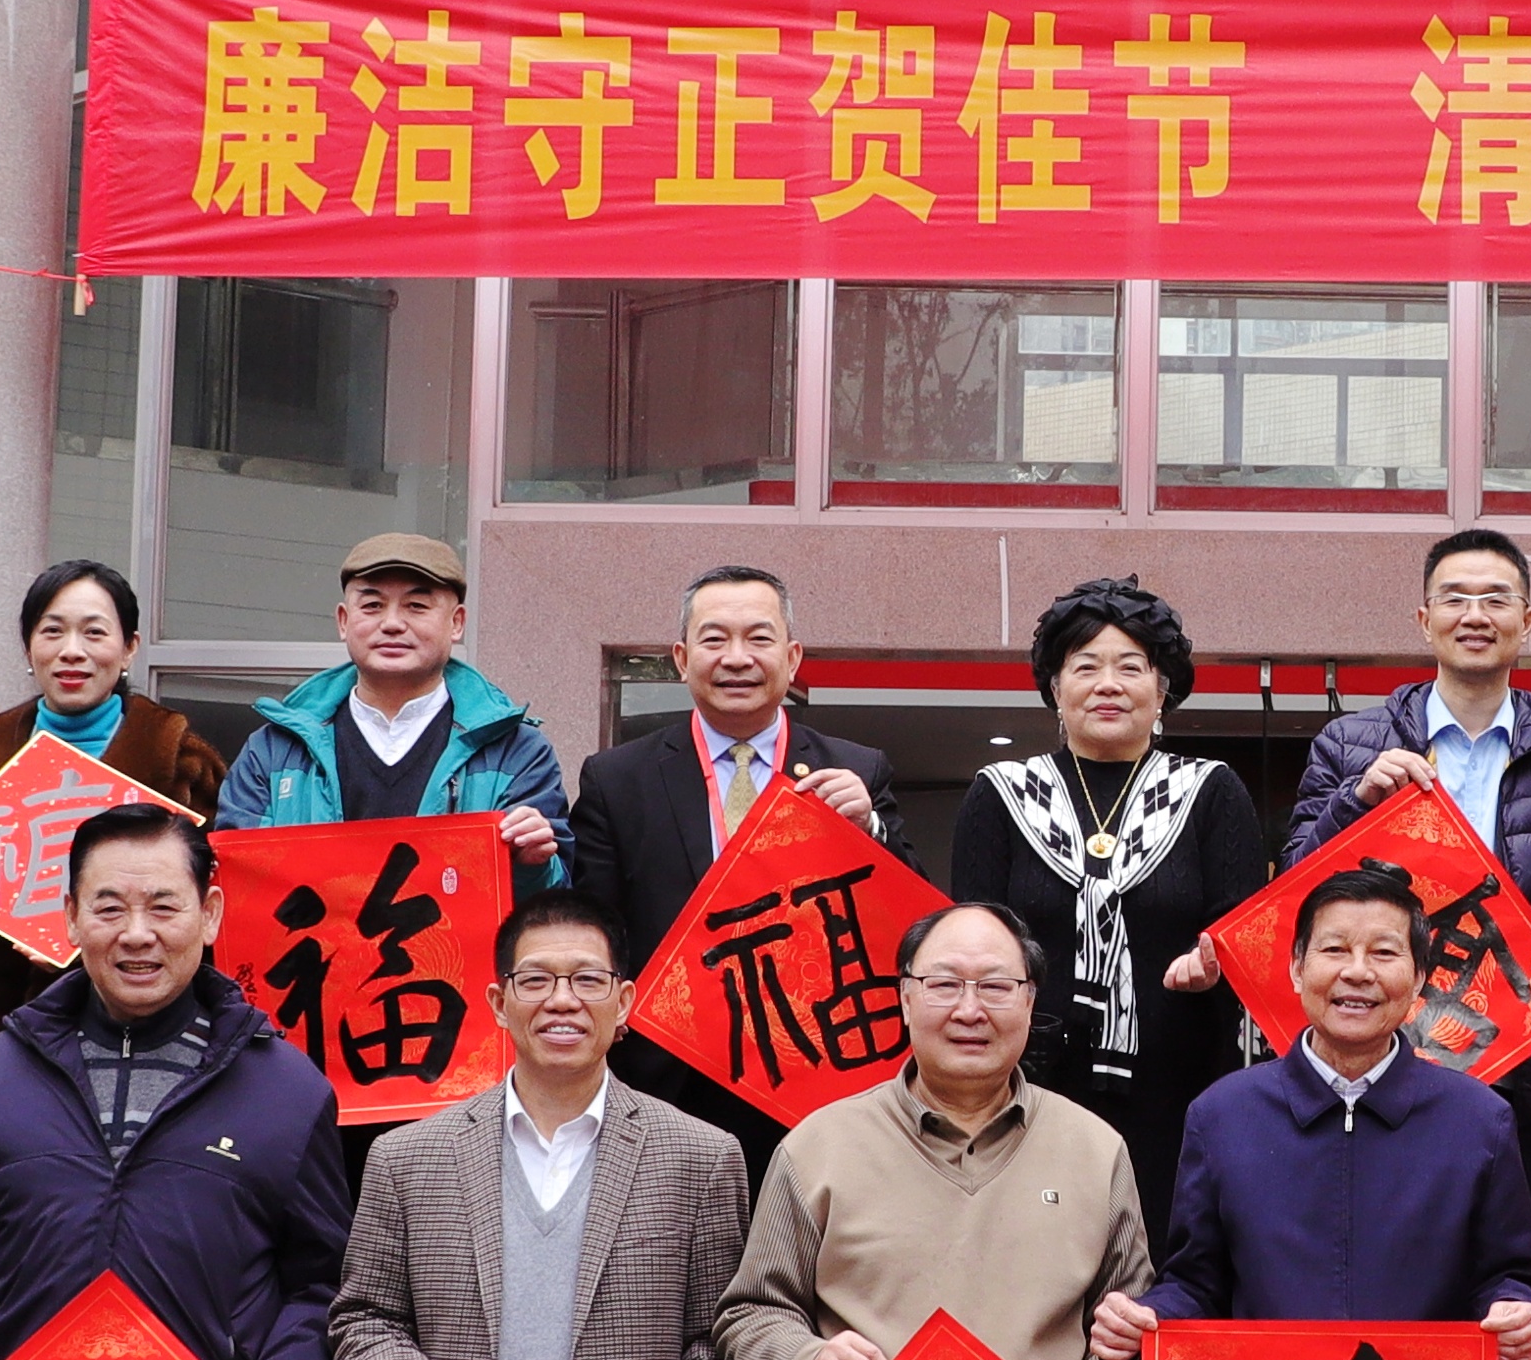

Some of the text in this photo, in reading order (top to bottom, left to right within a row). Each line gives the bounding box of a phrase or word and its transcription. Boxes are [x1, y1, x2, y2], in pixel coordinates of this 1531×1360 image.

[192, 6, 1247, 224] 廉洁守正贺佳节
[264, 842, 468, 1086] 福
[702, 863, 912, 1090] 福
